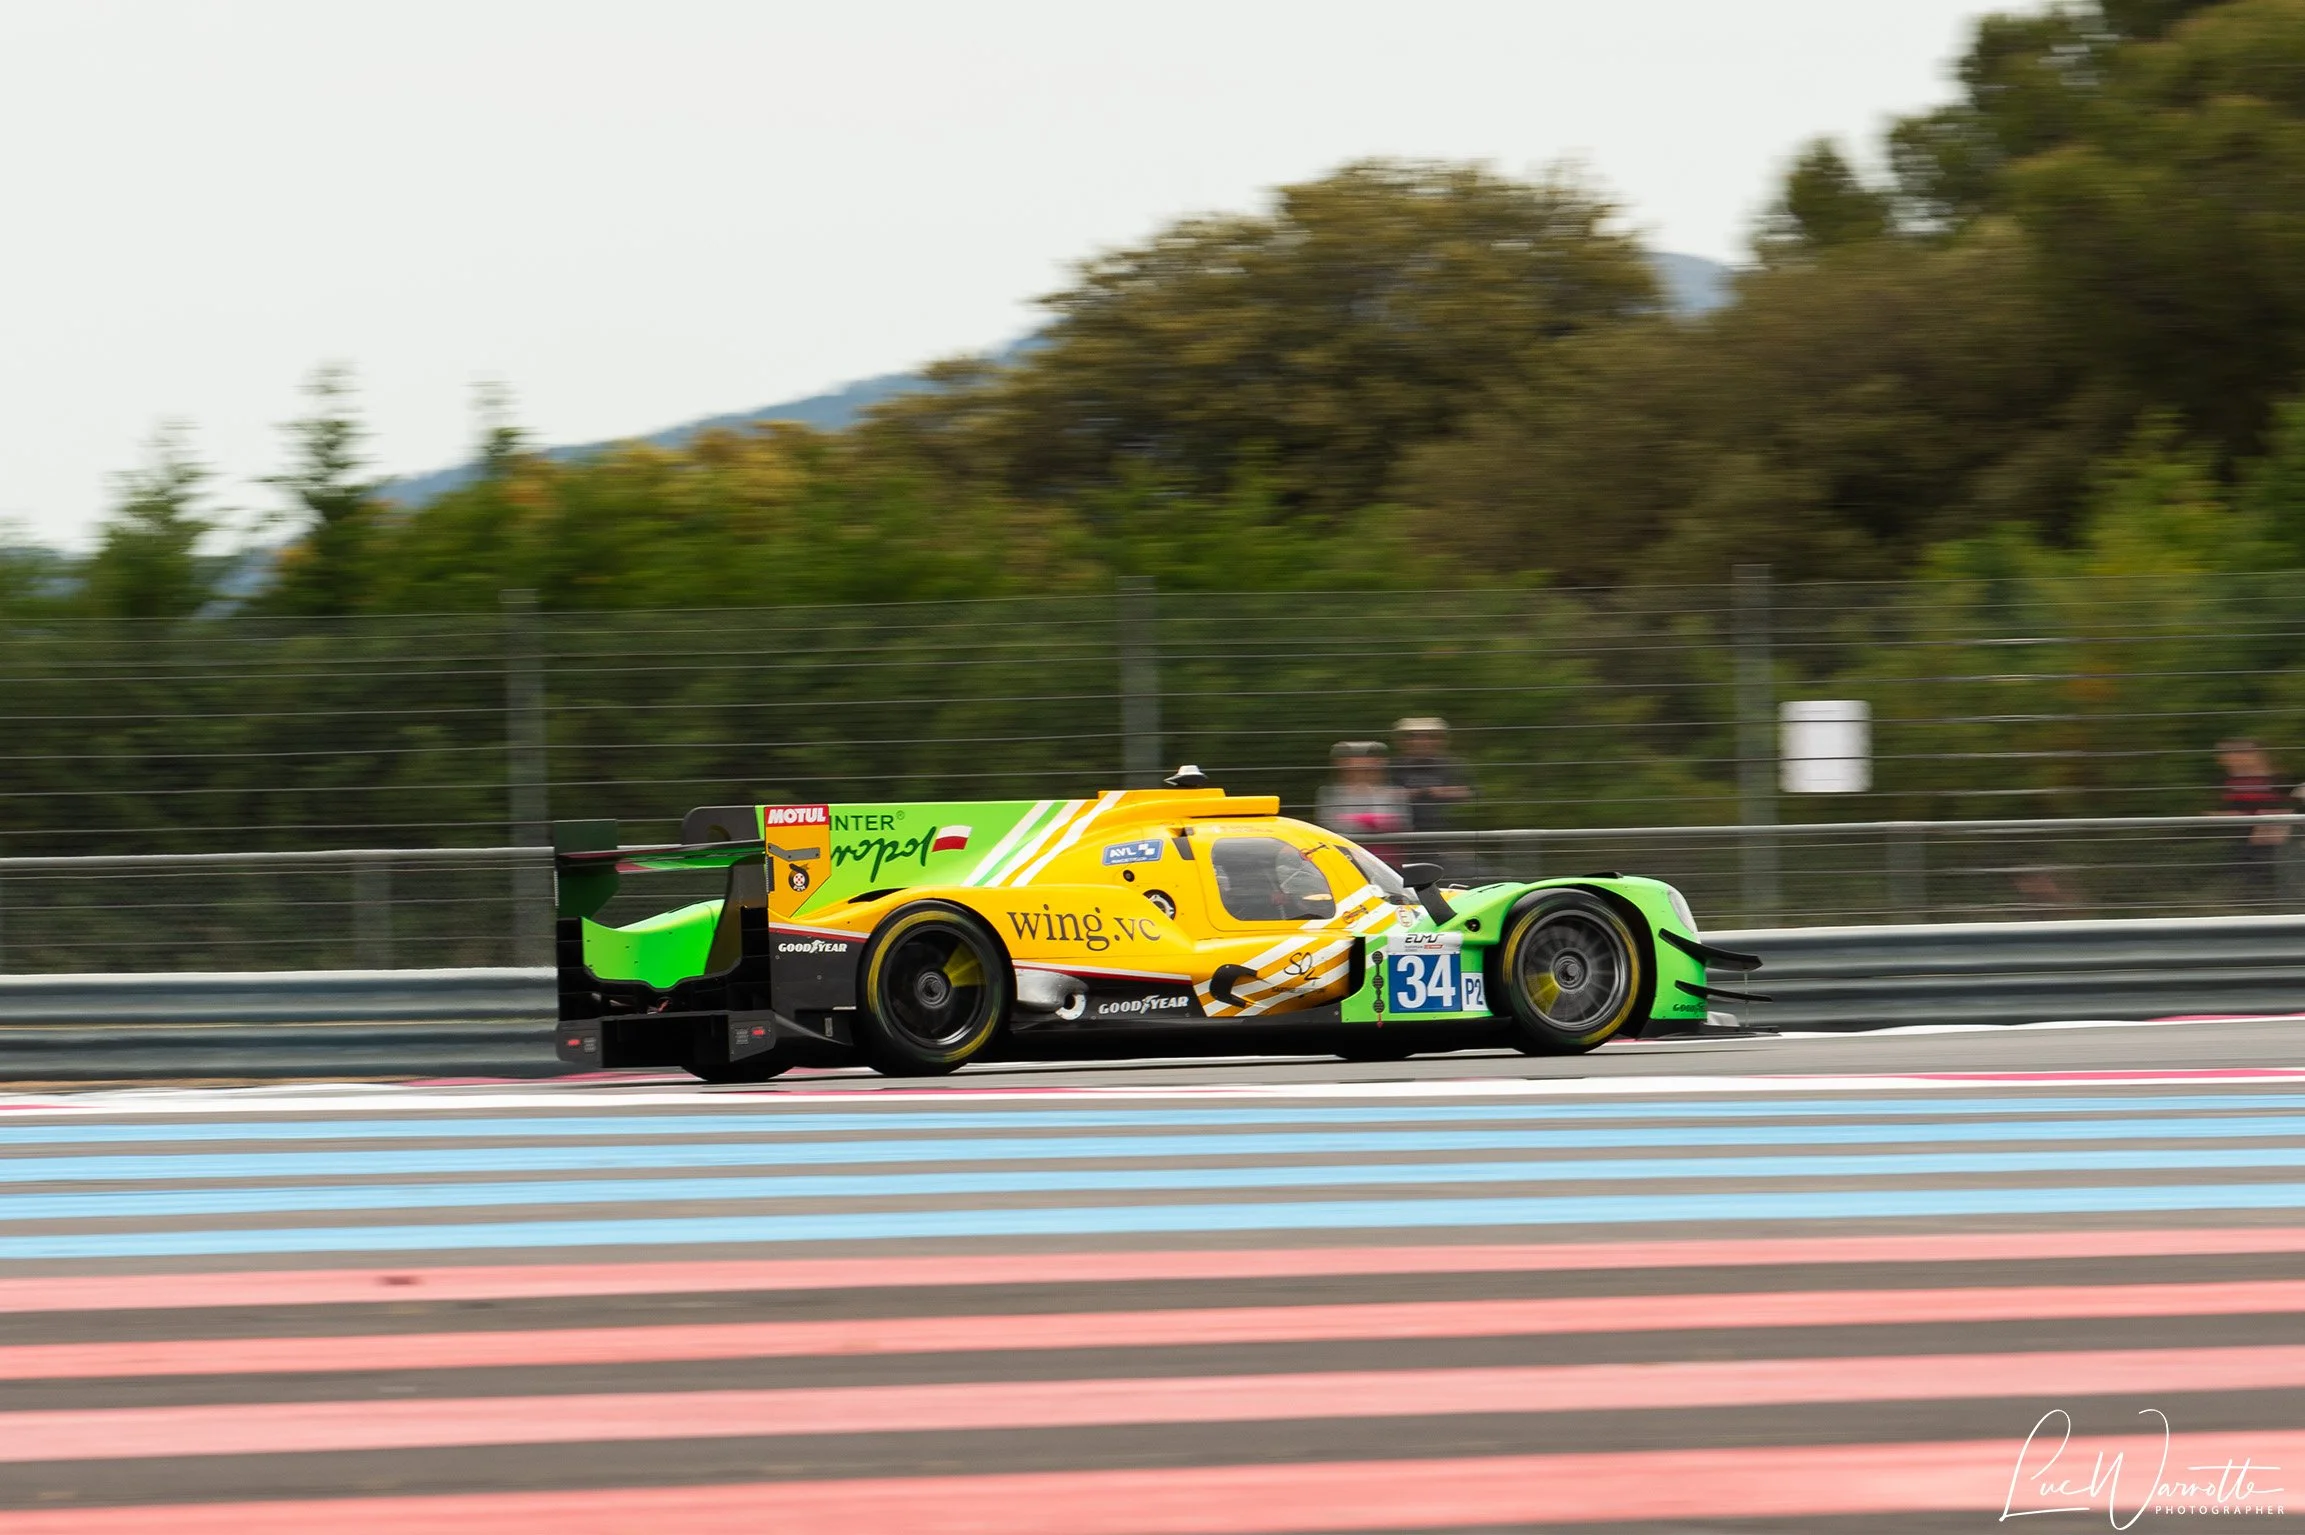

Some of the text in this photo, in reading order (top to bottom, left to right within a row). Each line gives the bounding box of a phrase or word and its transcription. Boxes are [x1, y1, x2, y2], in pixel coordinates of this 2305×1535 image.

[767, 807, 826, 824] MOTUL
[830, 815, 895, 831] INTER
[831, 826, 937, 883] ropol
[1110, 847, 1136, 858] AVL
[1007, 904, 1161, 951] wing.vc
[778, 939, 848, 953] GOODYEAR
[1397, 954, 1456, 1009] 34
[1465, 978, 1484, 1006] P2
[1099, 995, 1190, 1015] GOODYEAR
